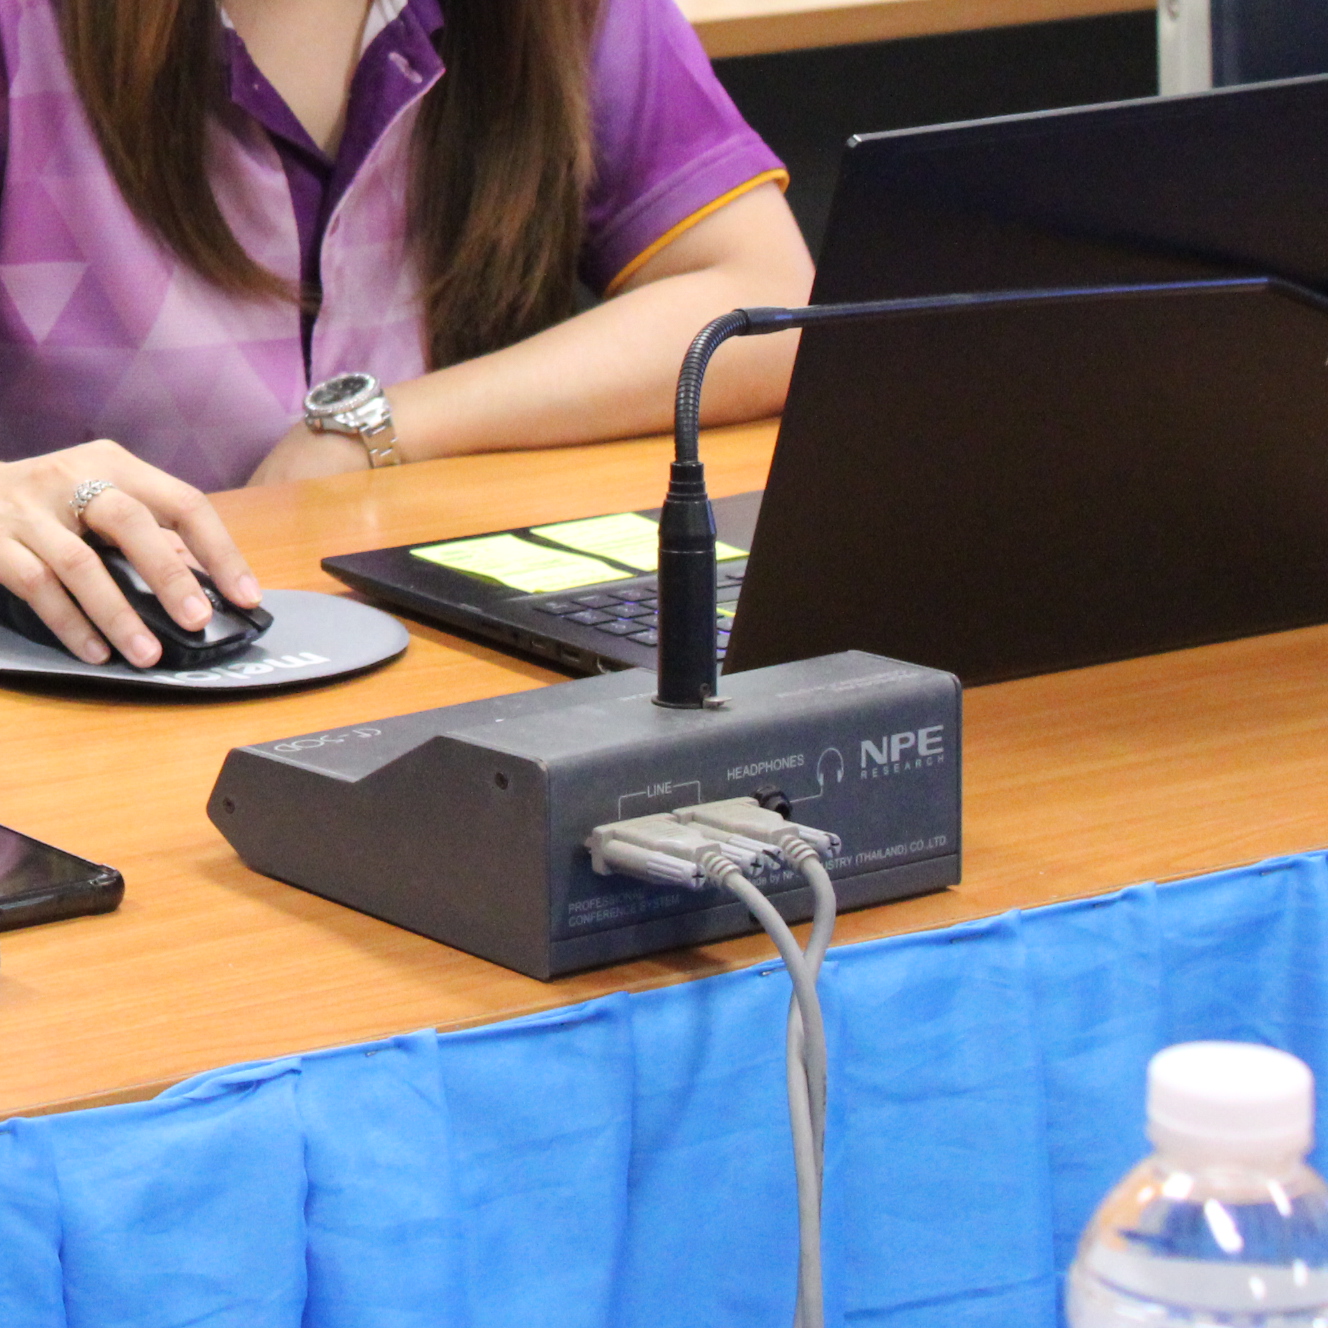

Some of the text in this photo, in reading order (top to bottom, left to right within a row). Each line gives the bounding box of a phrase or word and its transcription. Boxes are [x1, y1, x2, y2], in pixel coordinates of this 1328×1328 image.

[859, 724, 944, 768] NPE
[726, 754, 805, 781] HEADPHONES
[860, 755, 945, 780] RESEARCH
[647, 781, 673, 798] LINE
[855, 843, 908, 865] (THAILAND)
[568, 905, 637, 927] CONFERENCE
